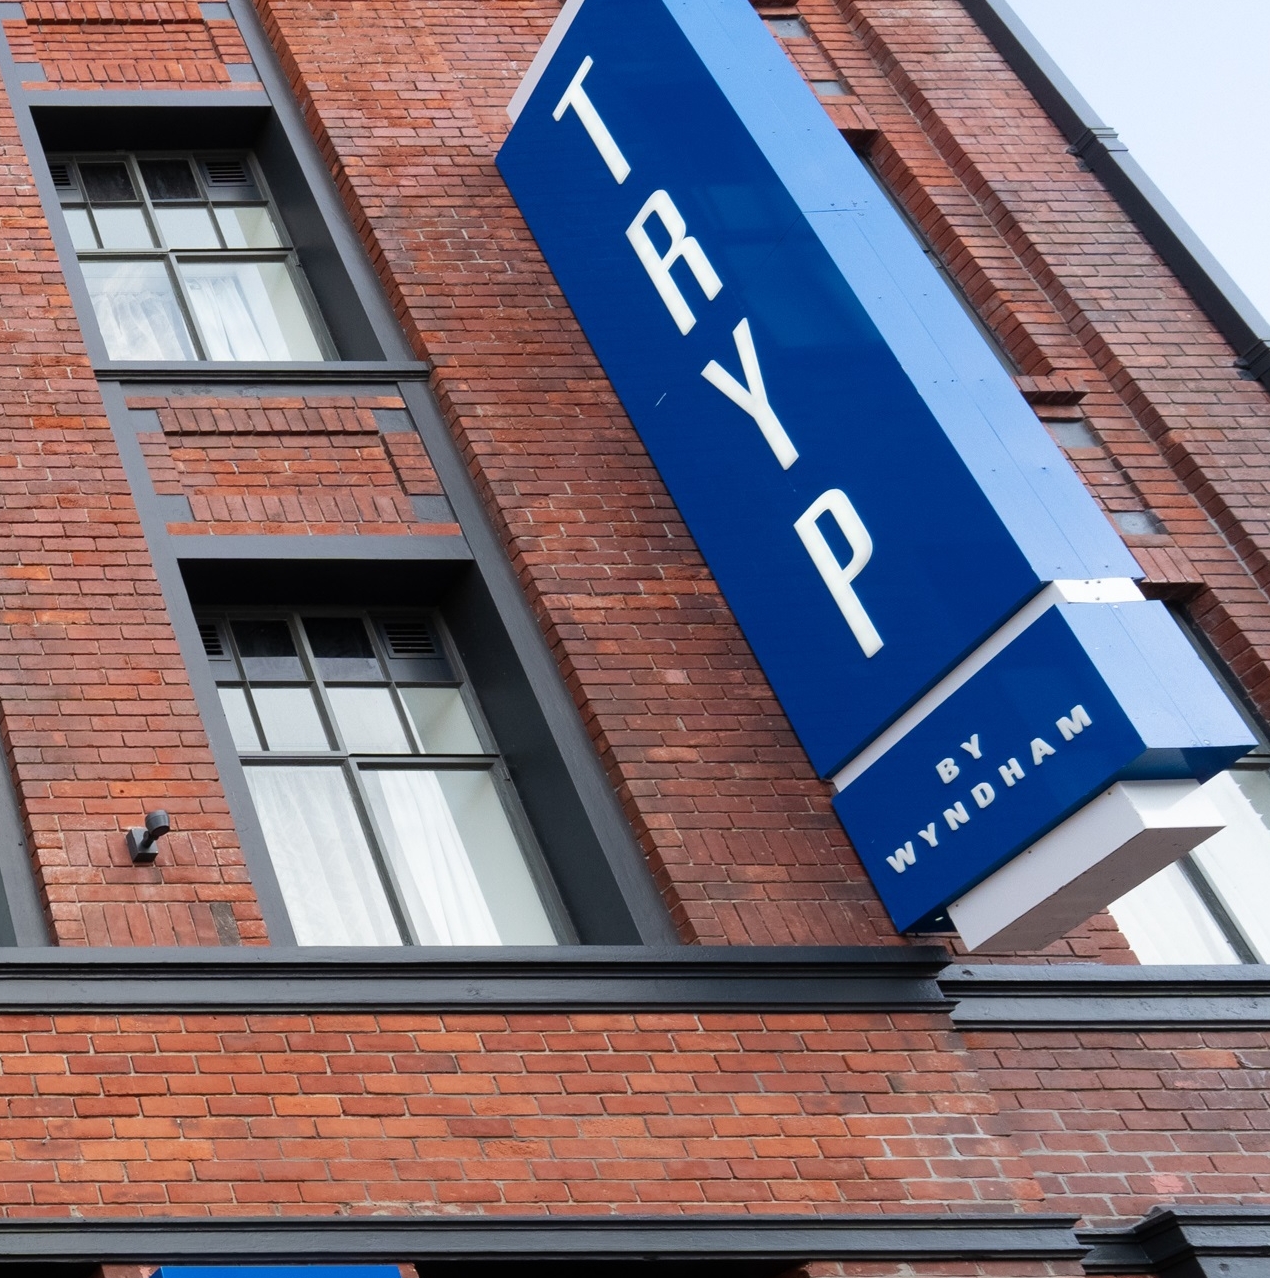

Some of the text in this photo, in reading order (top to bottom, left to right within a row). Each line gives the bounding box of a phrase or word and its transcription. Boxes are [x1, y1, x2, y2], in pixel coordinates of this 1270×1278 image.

[552, 55, 884, 659] TRYP
[885, 703, 1092, 875] WYNDHAM
[935, 732, 985, 786] BY
